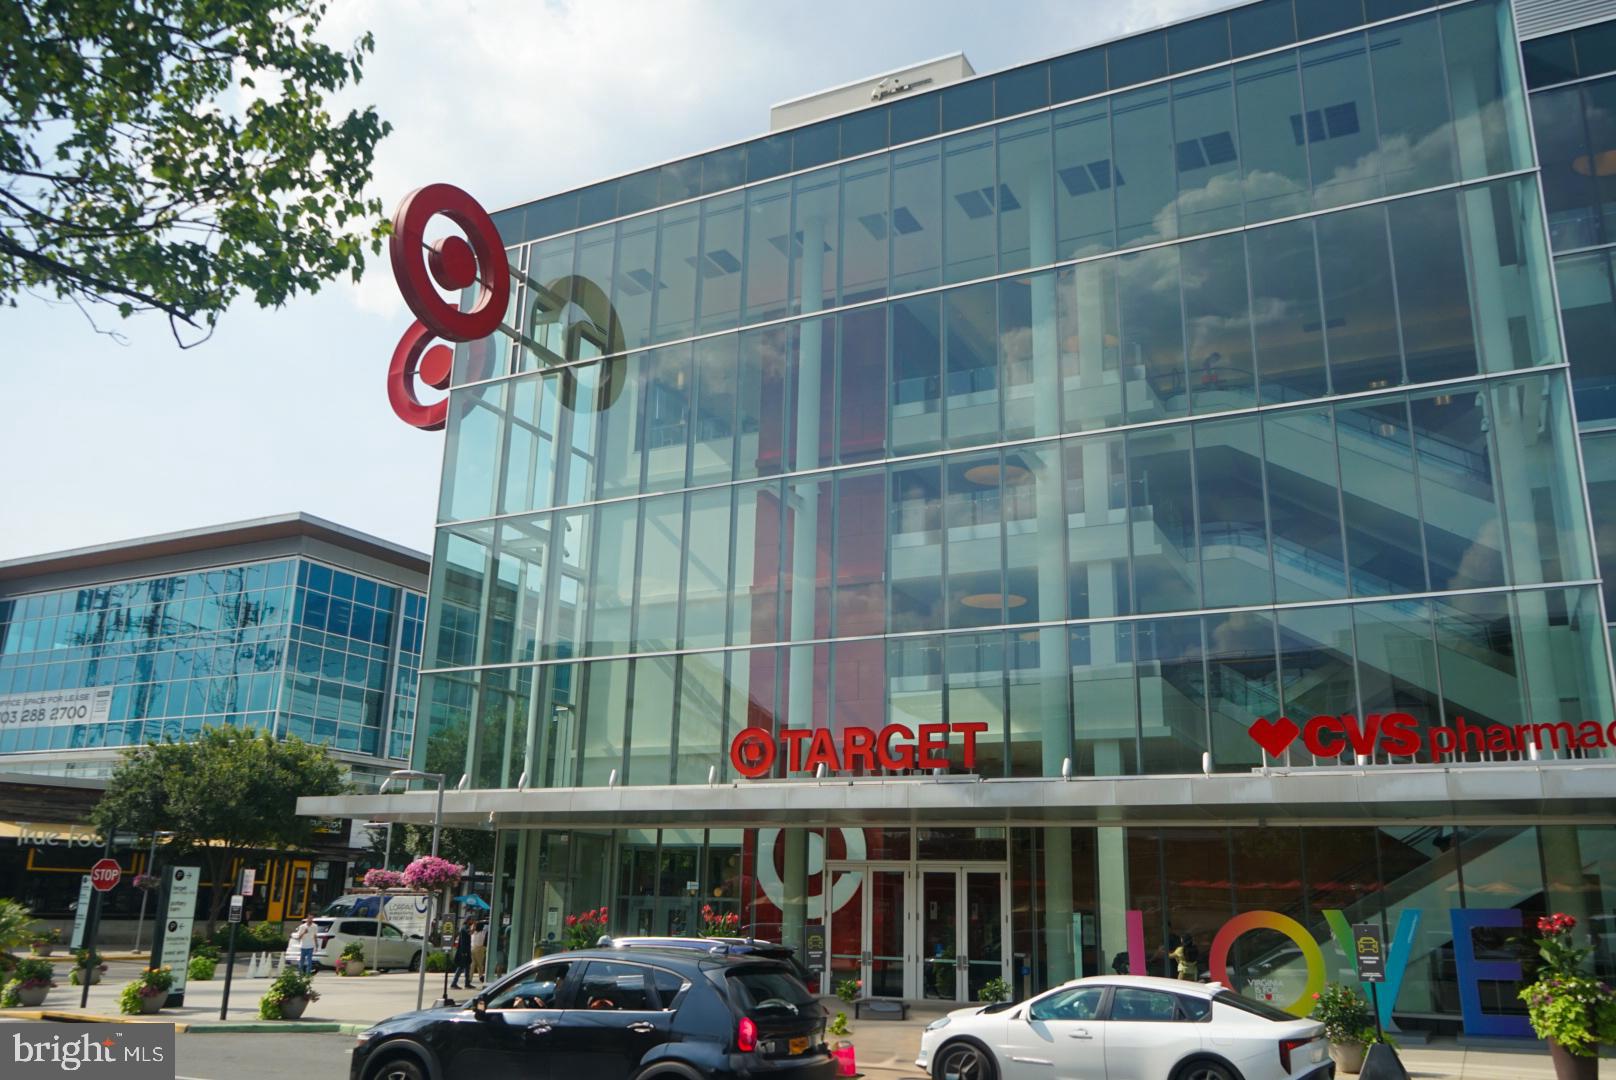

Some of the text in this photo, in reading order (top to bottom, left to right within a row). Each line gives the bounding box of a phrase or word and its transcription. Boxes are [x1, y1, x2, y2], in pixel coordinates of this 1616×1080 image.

[48, 695, 63, 703] FOR
[64, 693, 90, 702] LEASE
[0, 705, 87, 724] 03 288 2700
[1303, 712, 1421, 757] CVS
[779, 721, 988, 772] TARGET
[16, 821, 60, 847] True
[93, 869, 119, 881] STOP
